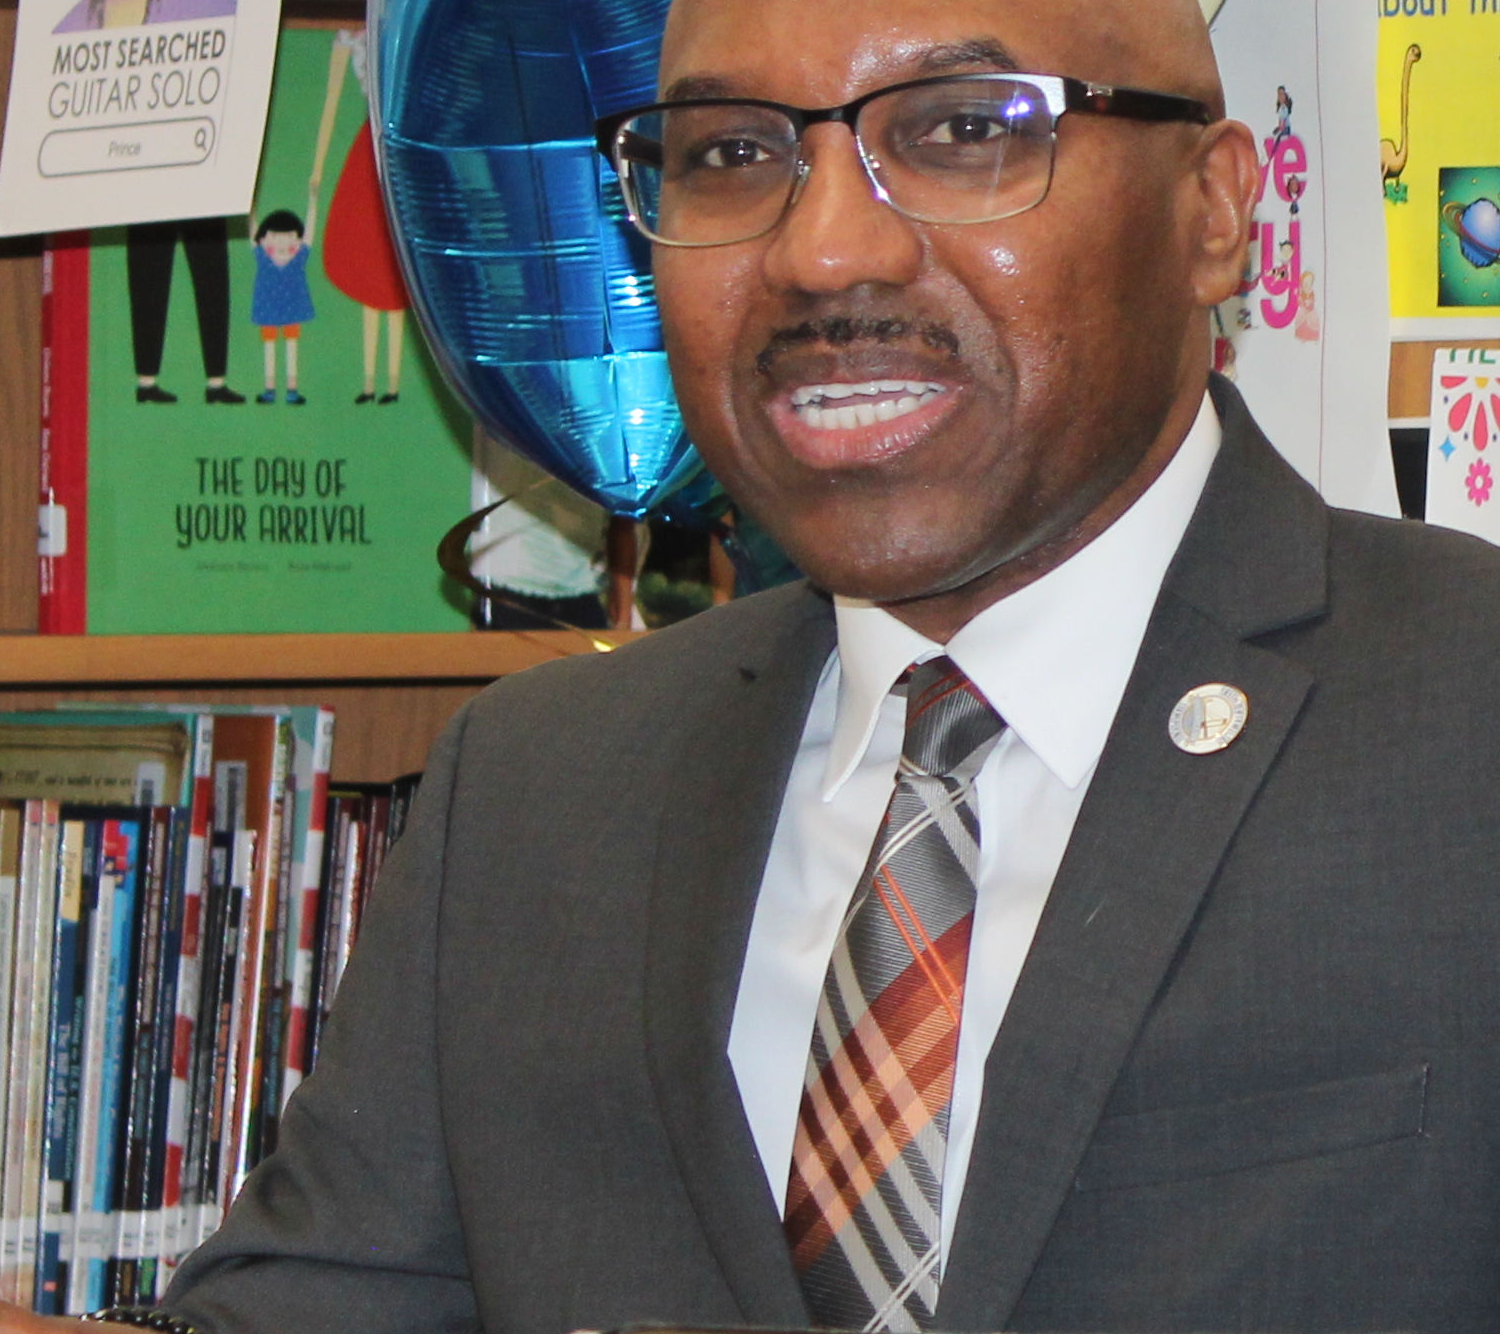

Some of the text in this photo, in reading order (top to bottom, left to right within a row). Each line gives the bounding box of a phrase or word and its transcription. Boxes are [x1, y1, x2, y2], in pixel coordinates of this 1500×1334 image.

[51, 28, 226, 75] MOST SEARCHED
[48, 66, 221, 120] GUITAR SOLO
[107, 139, 142, 160] Prince
[194, 457, 349, 501] THE DAY OF
[175, 503, 373, 550] YOUR ARRIVAL
